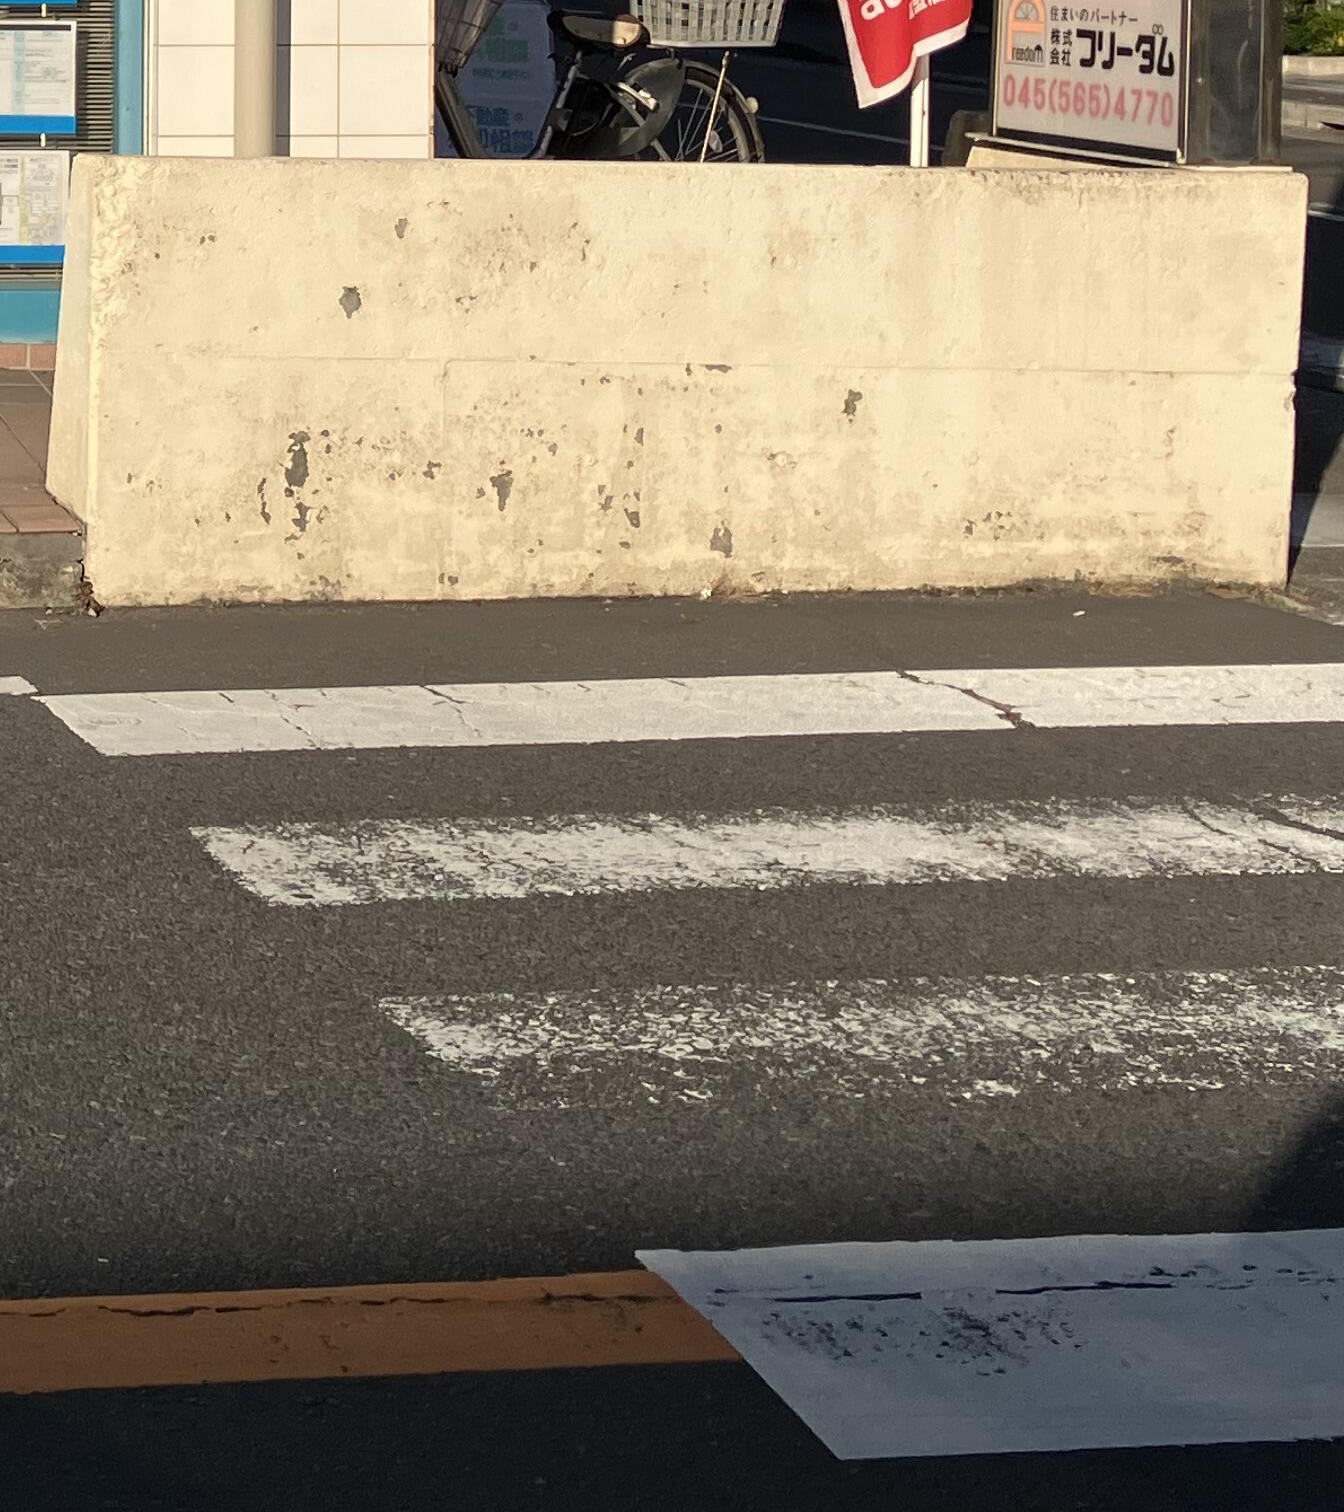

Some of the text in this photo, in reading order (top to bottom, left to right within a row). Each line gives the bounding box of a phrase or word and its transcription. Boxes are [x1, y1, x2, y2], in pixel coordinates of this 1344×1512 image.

[1076, 23, 1176, 77] フリーダム
